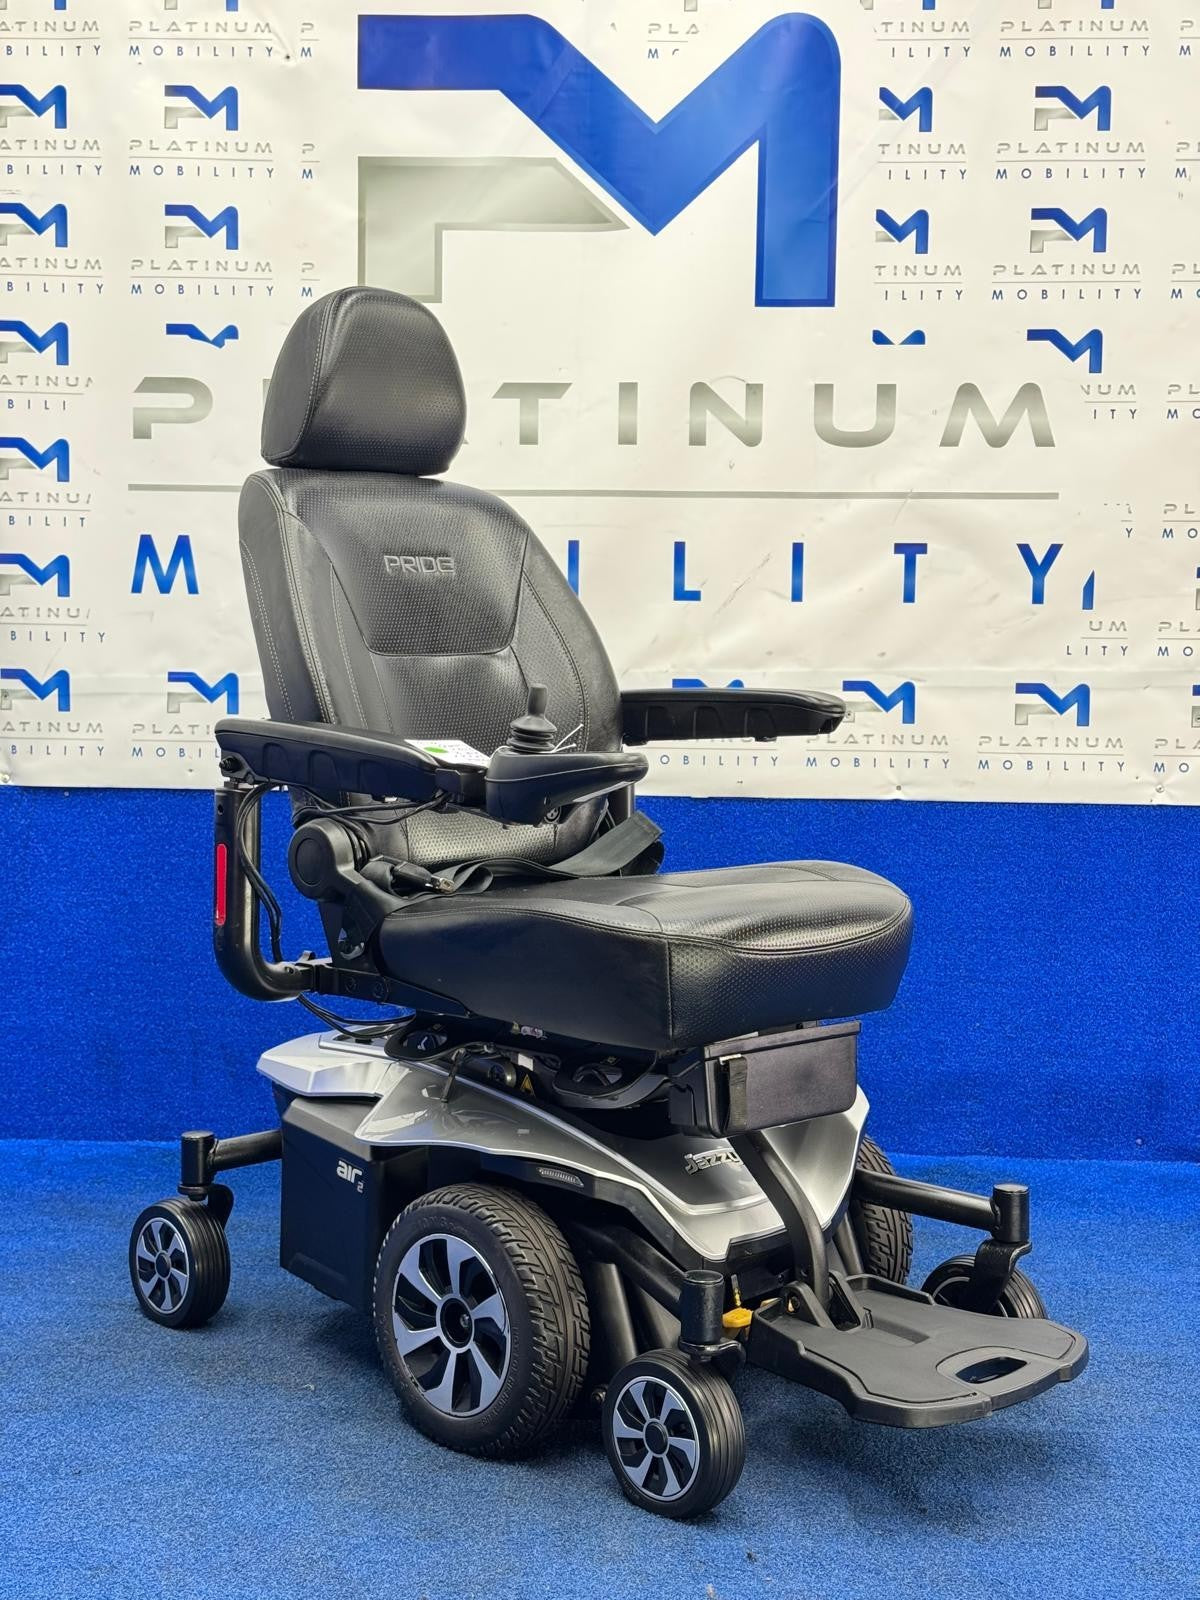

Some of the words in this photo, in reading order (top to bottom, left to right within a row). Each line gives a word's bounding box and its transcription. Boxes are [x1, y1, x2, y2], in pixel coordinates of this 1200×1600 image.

[129, 20, 272, 33] PLATINUM
[648, 23, 698, 35] PLA
[874, 21, 970, 33] TINUM
[1000, 20, 1149, 32] PLATINUM
[6, 44, 101, 57] BILITY
[128, 45, 273, 57] MOBILITY
[999, 45, 1150, 57] MOBILITY
[129, 139, 273, 154] PLATINUM
[996, 141, 1145, 154] PLATINUM
[6, 164, 102, 176] BILITY
[129, 164, 274, 179] MOBILITY
[995, 167, 1146, 180] MOBILITY
[130, 259, 272, 273] PLATINUM
[992, 263, 1140, 276] PLATINUM
[6, 281, 104, 294] BILITY
[130, 283, 274, 297] MOBILITY
[991, 288, 1142, 301] MOBILITY
[132, 376, 1056, 449] PTINUM
[131, 533, 1064, 605] MILITY
[383, 554, 456, 574] PRIDE
[10, 630, 105, 643] BILITY
[2, 721, 103, 733] ATINUM
[978, 735, 1123, 749] PLATINUM
[10, 744, 104, 756] BILITY
[806, 756, 950, 769] MOBILITY
[978, 759, 1125, 772] MOBILITY
[336, 1160, 363, 1184] air
